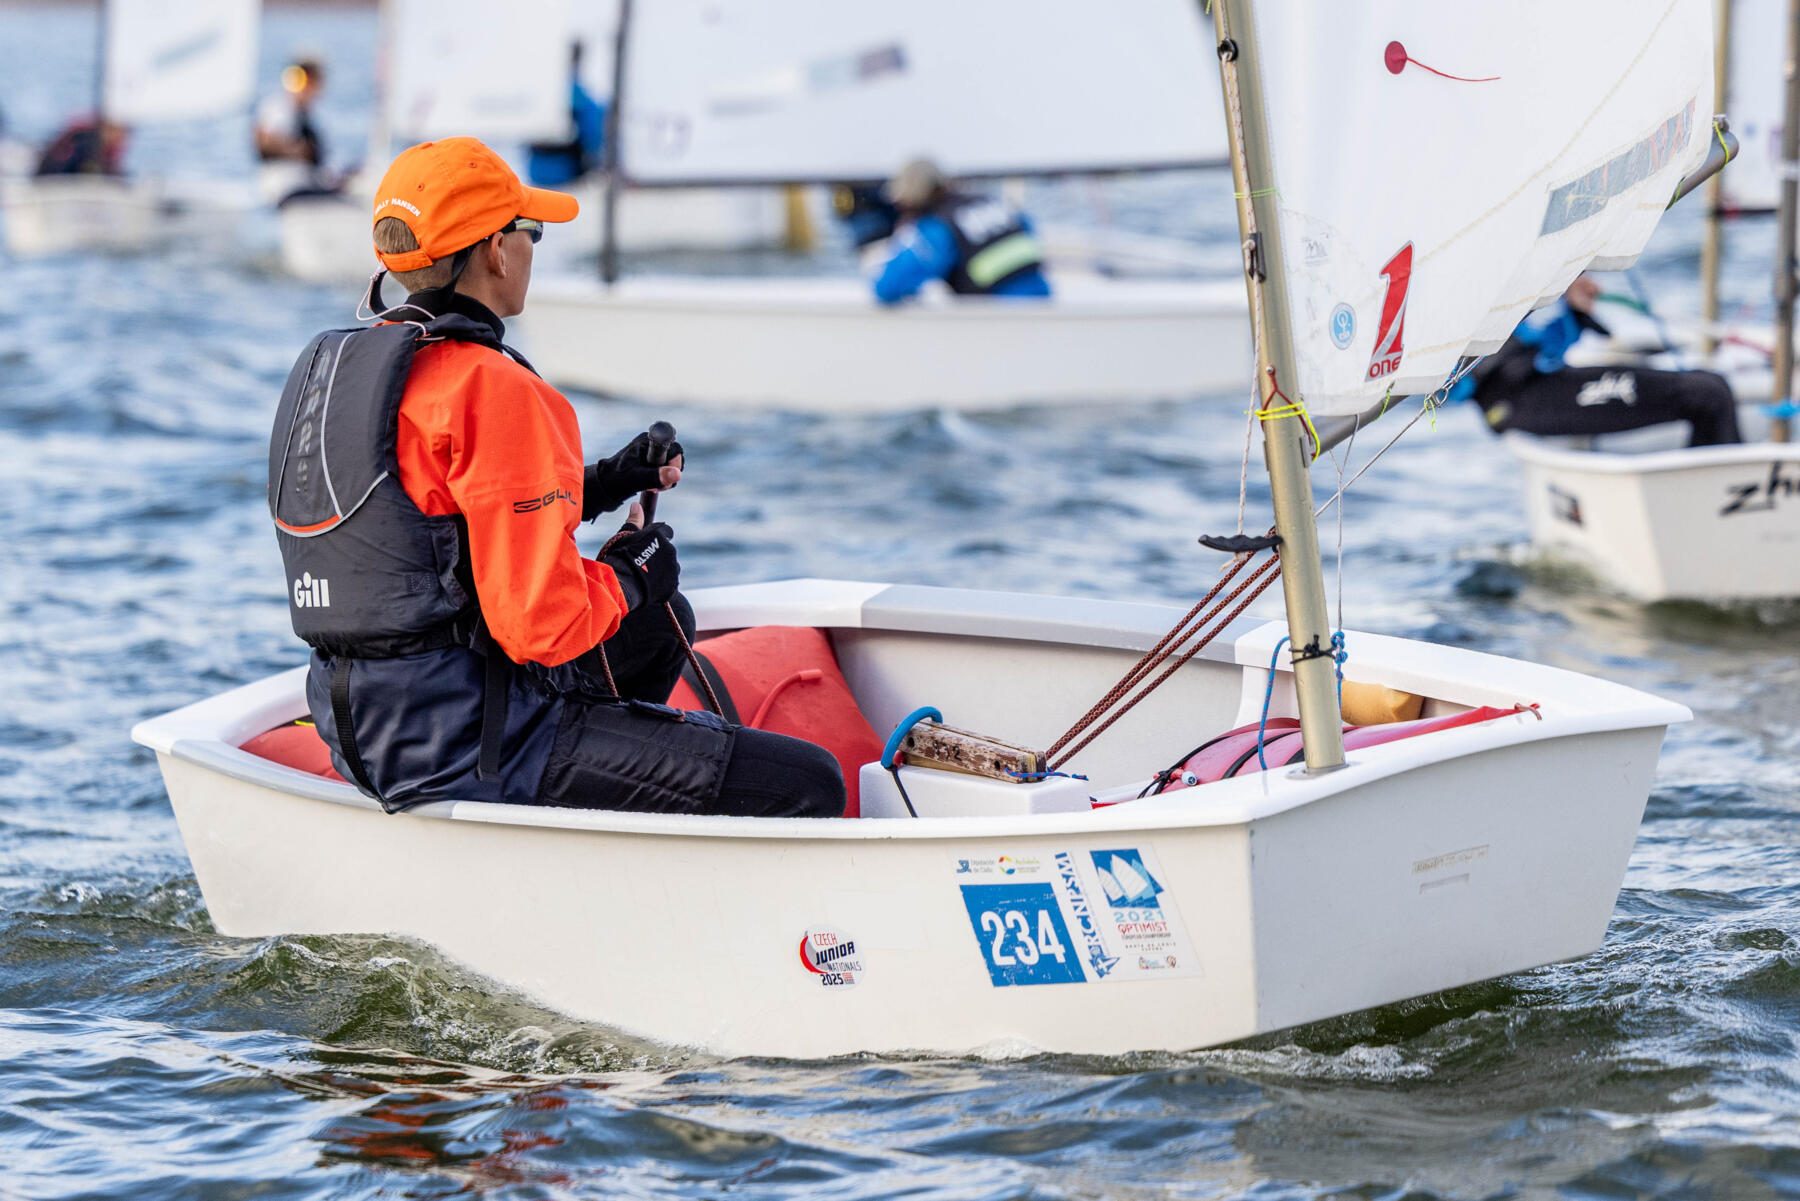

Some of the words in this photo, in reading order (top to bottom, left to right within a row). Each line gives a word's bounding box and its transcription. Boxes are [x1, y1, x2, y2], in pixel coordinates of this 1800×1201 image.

[391, 198, 421, 217] HANSEN
[1368, 356, 1402, 379] one
[1719, 459, 1800, 518] zh
[634, 537, 660, 567] MUSTO
[294, 571, 331, 608] Gill
[1113, 909, 1165, 923] 2021
[980, 909, 1066, 967] 234
[1117, 921, 1168, 935] OPTIMIST
[813, 932, 839, 947] CZECH
[815, 940, 856, 966] JUNIOR
[826, 960, 863, 972] NATIONALS
[820, 972, 845, 986] 2025
